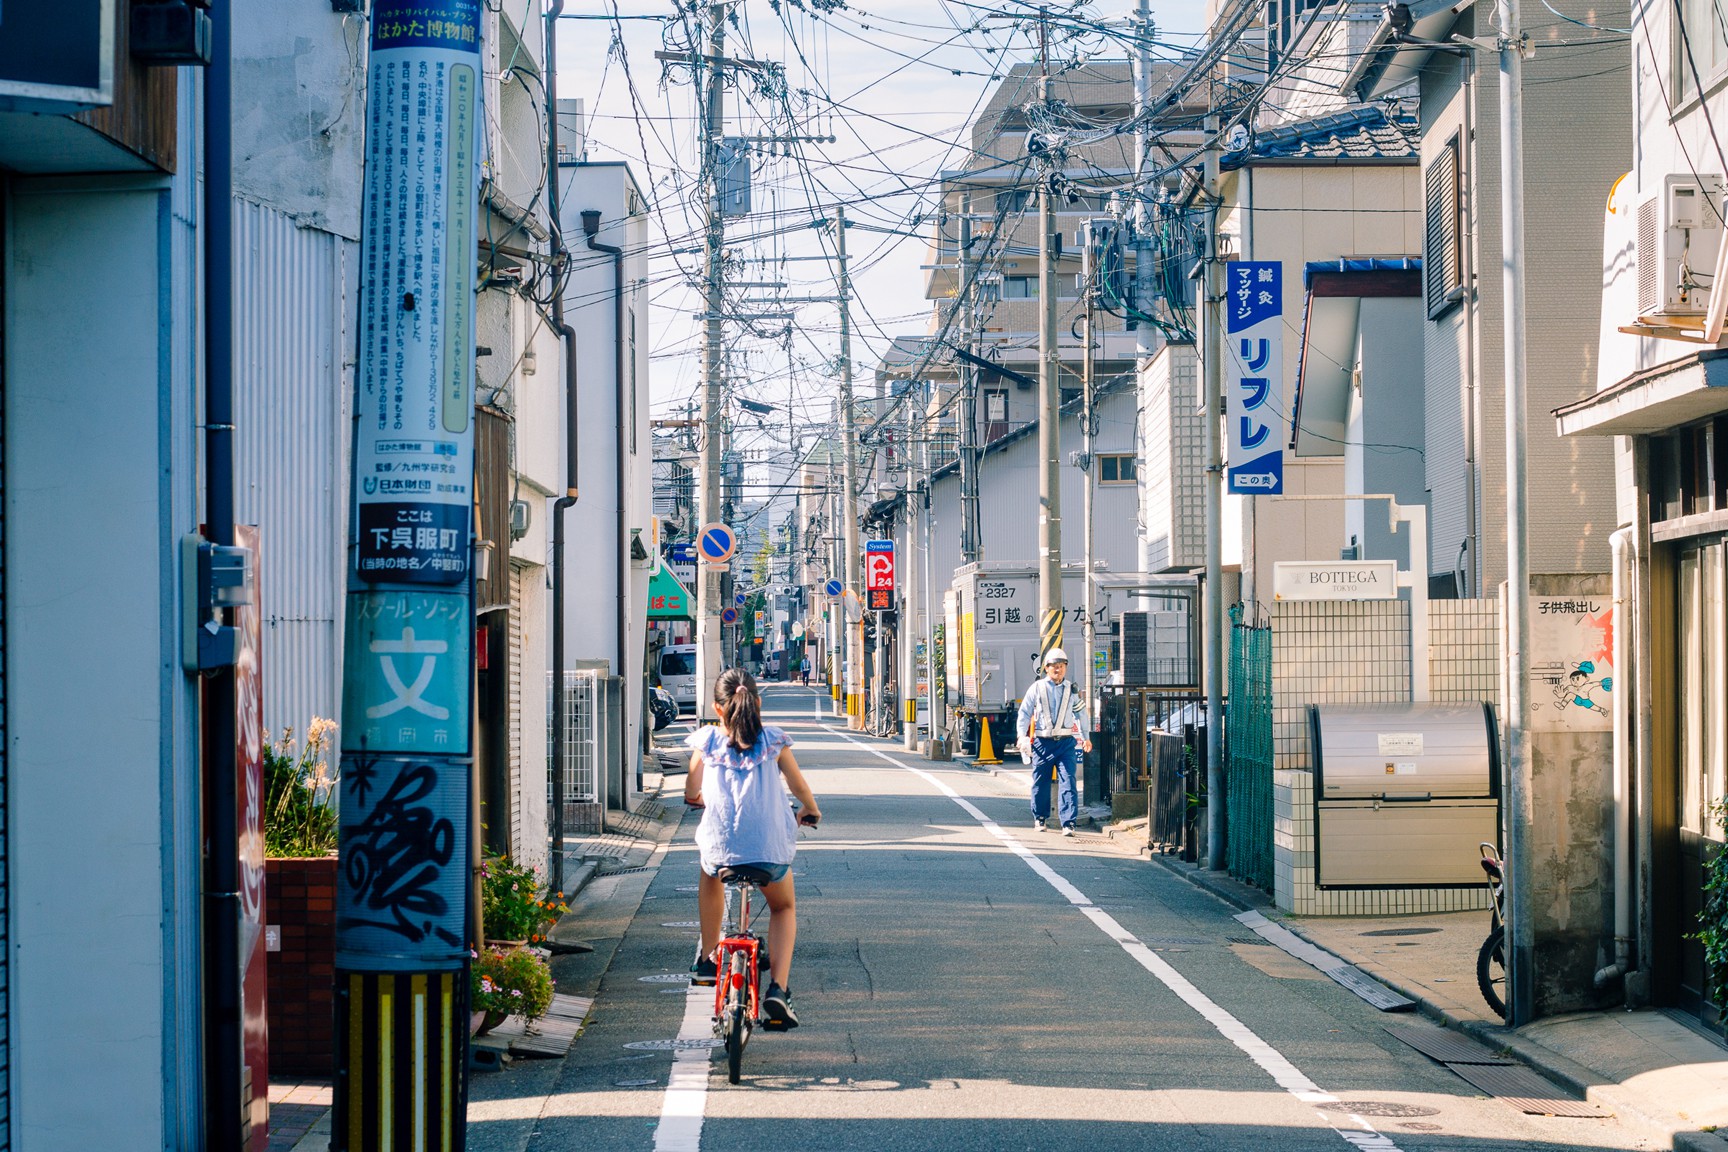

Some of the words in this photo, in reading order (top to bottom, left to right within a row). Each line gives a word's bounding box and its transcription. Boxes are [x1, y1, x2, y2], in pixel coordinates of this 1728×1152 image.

[378, 20, 475, 42] はかた博物館
[1236, 268, 1252, 319] マッサージ
[1258, 268, 1273, 304] 鍼灸
[1240, 338, 1270, 450] リフレ
[380, 480, 431, 490] 日本財団
[1240, 476, 1270, 484] この奥
[396, 510, 432, 522] ここは
[370, 528, 458, 551] 下呉服町
[877, 578, 892, 586] 24
[1310, 570, 1378, 584] BOTTEGA
[648, 596, 680, 610] ばこ
[872, 591, 889, 608] 満
[1538, 600, 1600, 614] 子供飛出し
[366, 626, 450, 720] 文
